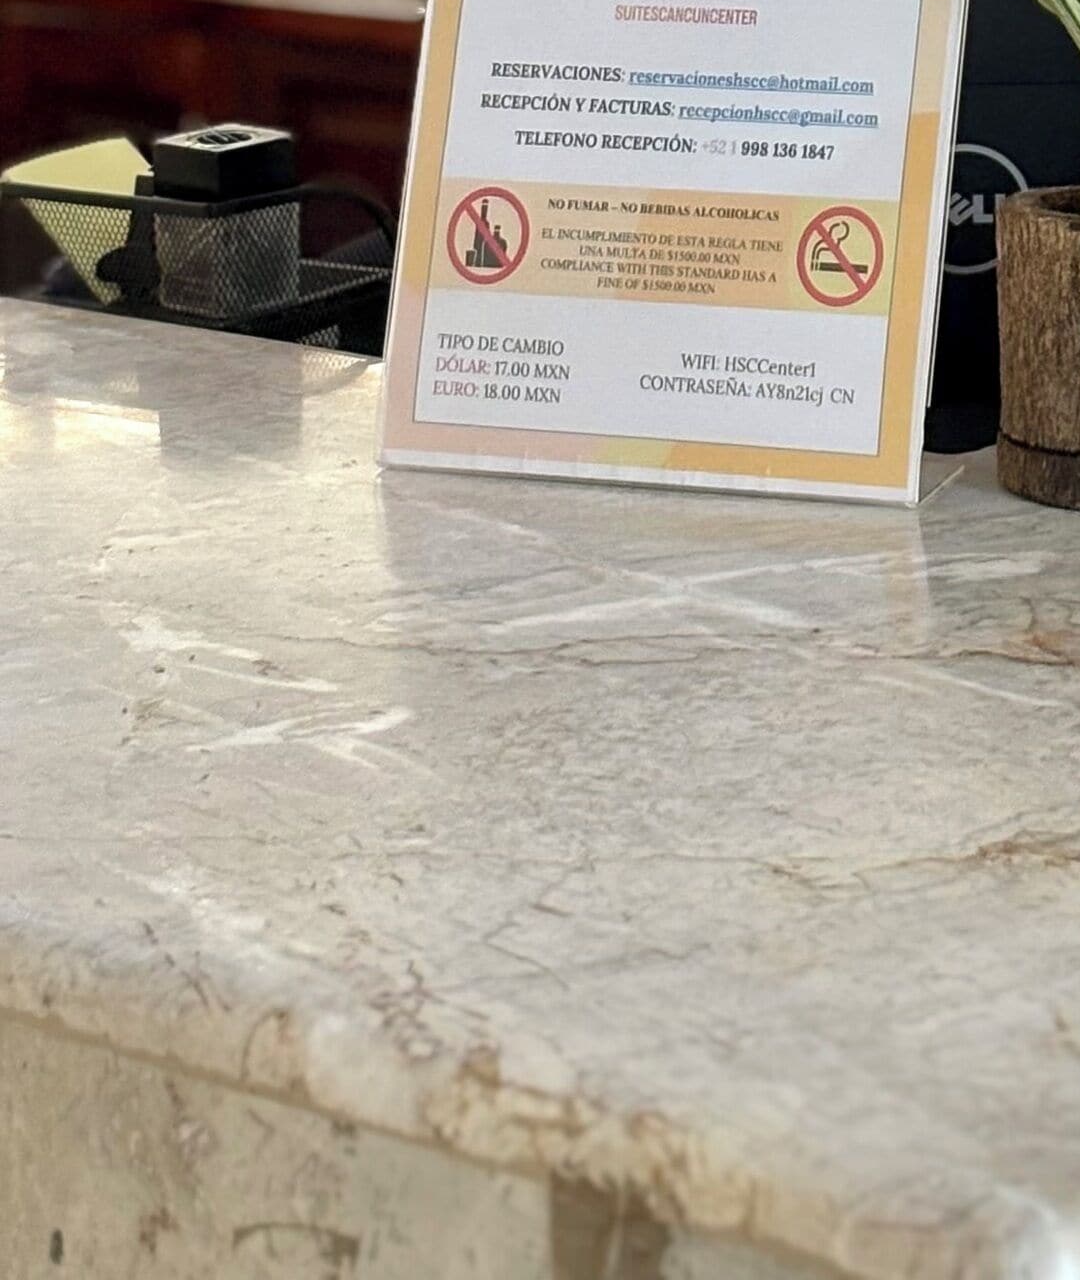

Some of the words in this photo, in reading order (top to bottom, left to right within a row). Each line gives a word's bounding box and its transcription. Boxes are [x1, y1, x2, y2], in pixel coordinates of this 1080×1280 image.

[614, 4, 758, 26] SUITESCANCUNCENTER
[491, 63, 626, 82] RESERVACIONES:
[629, 70, 874, 96] reservacioneshscc@hotmail.com
[480, 93, 571, 112] RECEPCIÓN
[575, 98, 587, 112] Y
[588, 99, 676, 116] FACTURAS:
[678, 104, 879, 128] recepcionhscc@gmail.com
[515, 130, 597, 148] TELEFONO
[601, 133, 697, 153] RECEPCIÓN:
[741, 141, 769, 156] 998
[772, 143, 797, 158] 136
[801, 144, 835, 160] 1847
[548, 198, 565, 210] NO
[567, 200, 609, 212] FUMAR
[620, 202, 638, 214] NO
[639, 203, 690, 217] BEBIDAS
[694, 206, 779, 222] ALCOHOLICAS
[541, 227, 556, 240] EL
[557, 229, 658, 246] INCUMPLIMIENTO
[659, 235, 674, 246] DE
[677, 235, 706, 248] ESTA
[708, 238, 747, 250] REGLA
[749, 240, 783, 252] TIENE
[579, 245, 602, 257] UNA
[606, 246, 646, 260] MULTA
[649, 249, 664, 261] DE
[667, 249, 711, 263] $1500.00
[713, 252, 740, 265] MXN
[541, 258, 614, 273] COMPLIANCE
[617, 263, 646, 276] WITH
[649, 264, 674, 277] THIS
[676, 266, 740, 280] STANDARD
[742, 270, 766, 282] HAS
[768, 271, 777, 283] A
[597, 276, 623, 289] FINE
[625, 278, 640, 290] OF
[688, 282, 716, 294] MXN
[437, 333, 474, 351] TIPO
[477, 336, 499, 352] DE
[502, 337, 564, 357] CAMBIO
[435, 354, 491, 375] DÓLAR:
[494, 361, 530, 378] 17.00
[533, 363, 570, 381] MXN
[432, 380, 479, 398] EURO:
[483, 383, 520, 400] 18.00
[524, 386, 561, 404] MXN
[639, 374, 750, 397] CONTRASEÑA:
[830, 388, 855, 404] CN
